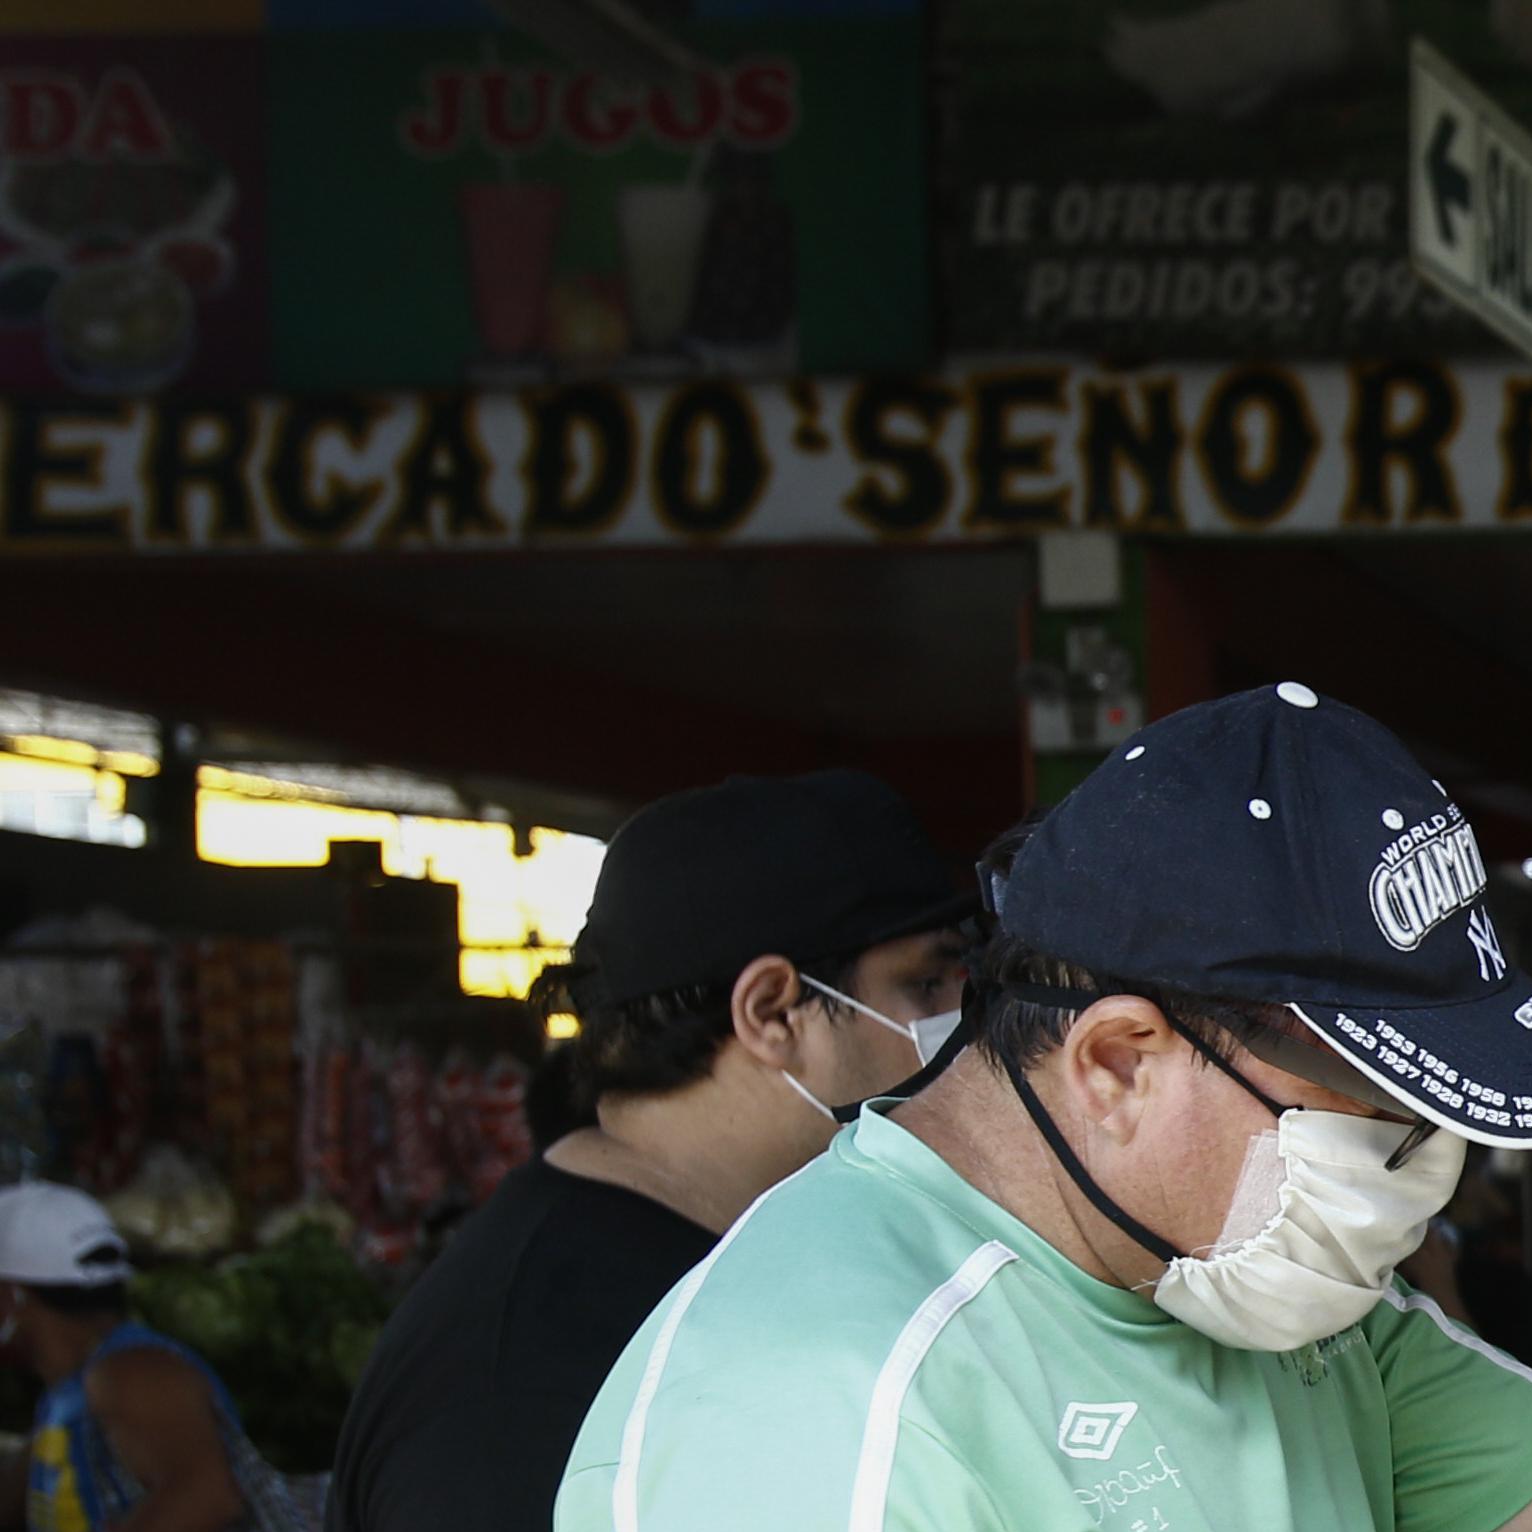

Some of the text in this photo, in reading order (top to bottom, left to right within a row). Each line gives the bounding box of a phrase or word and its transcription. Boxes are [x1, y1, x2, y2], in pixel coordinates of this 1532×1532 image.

[408, 63, 795, 151] JUGOS
[973, 180, 1396, 246] LE OFRECE POR
[1024, 258, 1313, 321] PEDIDOS:
[1380, 813, 1449, 866] WORLD
[1335, 1012, 1378, 1051] 1923
[1377, 1045, 1422, 1080] 1927
[1420, 1074, 1465, 1109] 1928
[1466, 1102, 1512, 1127] 1932
